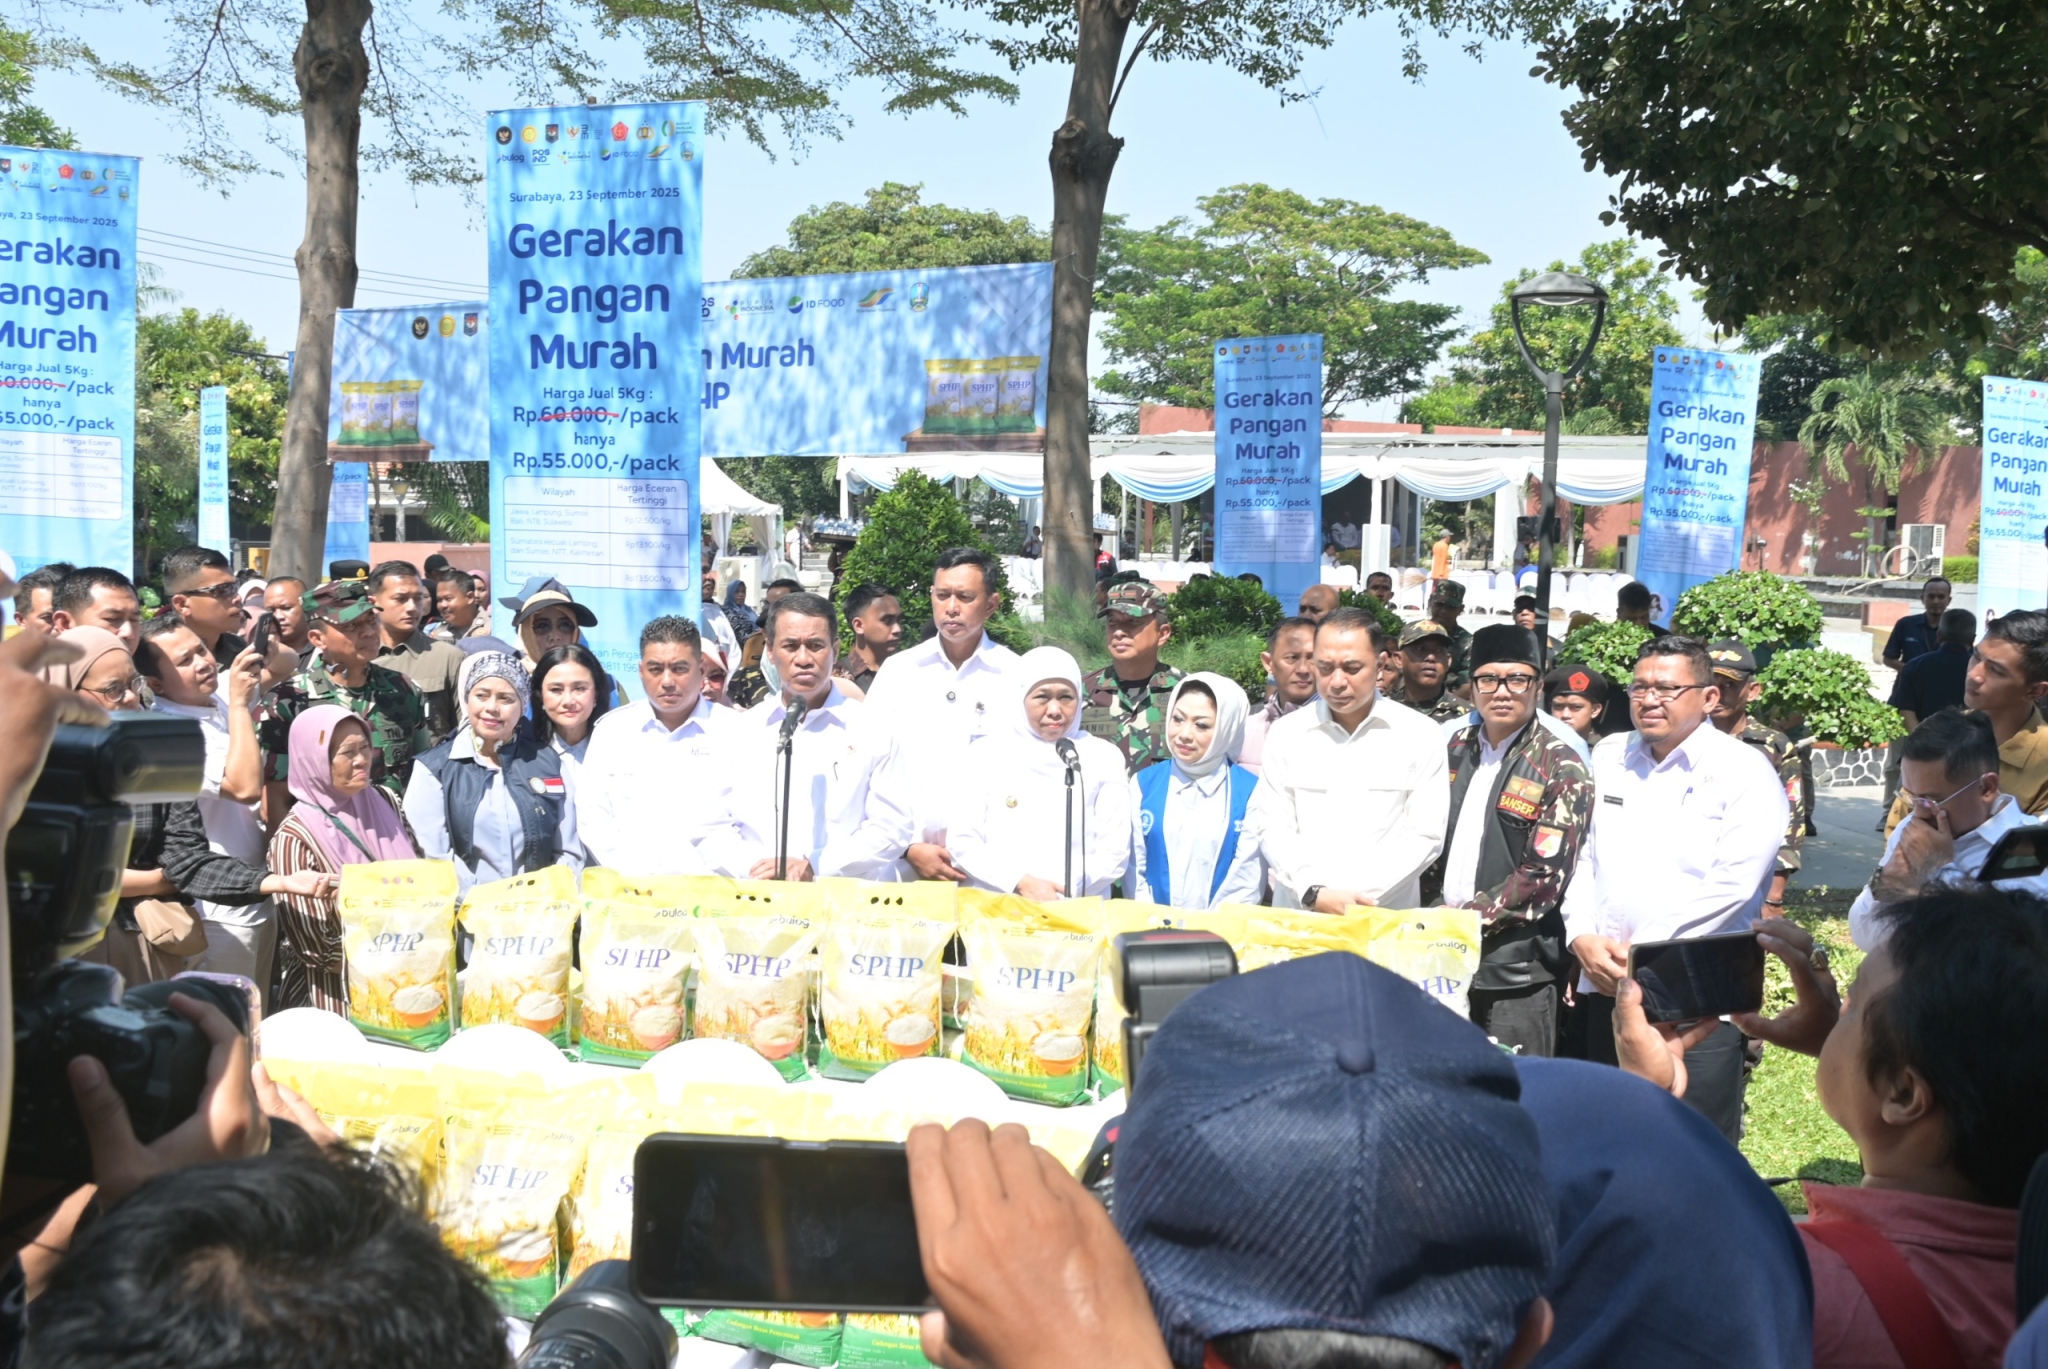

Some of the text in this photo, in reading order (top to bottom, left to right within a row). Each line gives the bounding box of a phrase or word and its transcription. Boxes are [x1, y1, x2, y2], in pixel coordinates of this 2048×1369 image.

[502, 152, 525, 163] bulog
[510, 188, 680, 204] Surabaya, 23 September 2025
[20, 212, 33, 220] 23
[36, 213, 89, 225] September
[93, 217, 118, 227] 2025
[508, 219, 683, 259] Gerakan
[0, 237, 120, 270] erakan
[0, 282, 108, 316] angan
[518, 278, 670, 323] Pangan
[818, 299, 845, 308] FOOD
[530, 332, 657, 370] Murah
[721, 337, 815, 370] Murah
[36, 363, 60, 373] Jual
[971, 384, 995, 393] SPHP
[1007, 380, 1031, 390] SPHP
[23, 396, 61, 411] hanya
[543, 387, 584, 402] Harga
[588, 387, 614, 399] Jual
[1224, 388, 1313, 408] Gerakan
[1658, 400, 1745, 425] Gerakan
[1230, 418, 1307, 437] Pangan
[574, 432, 615, 449] hanya
[1661, 426, 1736, 452] Pangan
[73, 447, 106, 456] Tertinggi
[1236, 441, 1300, 460] Murah
[1664, 452, 1727, 476] Murah
[1991, 452, 2047, 475] Pangan
[617, 484, 676, 494] Harga Eceran
[1669, 478, 1692, 487] Harga
[1994, 476, 2041, 496] Murah
[541, 488, 575, 498] Wilayah
[628, 496, 668, 506] Tertinggi
[1256, 488, 1279, 497] hanya
[612, 649, 640, 660] Penga
[623, 663, 638, 672] 196
[1500, 795, 1535, 816] BANSER
[368, 932, 424, 953] SPHP
[484, 936, 554, 956] SPHP
[722, 952, 791, 978] SPHP
[849, 954, 924, 979] SPHP
[997, 966, 1075, 993] SPHP
[1421, 976, 1461, 994] HP
[608, 1027, 616, 1039] 5
[754, 1325, 768, 1333] Beras
[769, 1328, 800, 1340] Pemerintah
